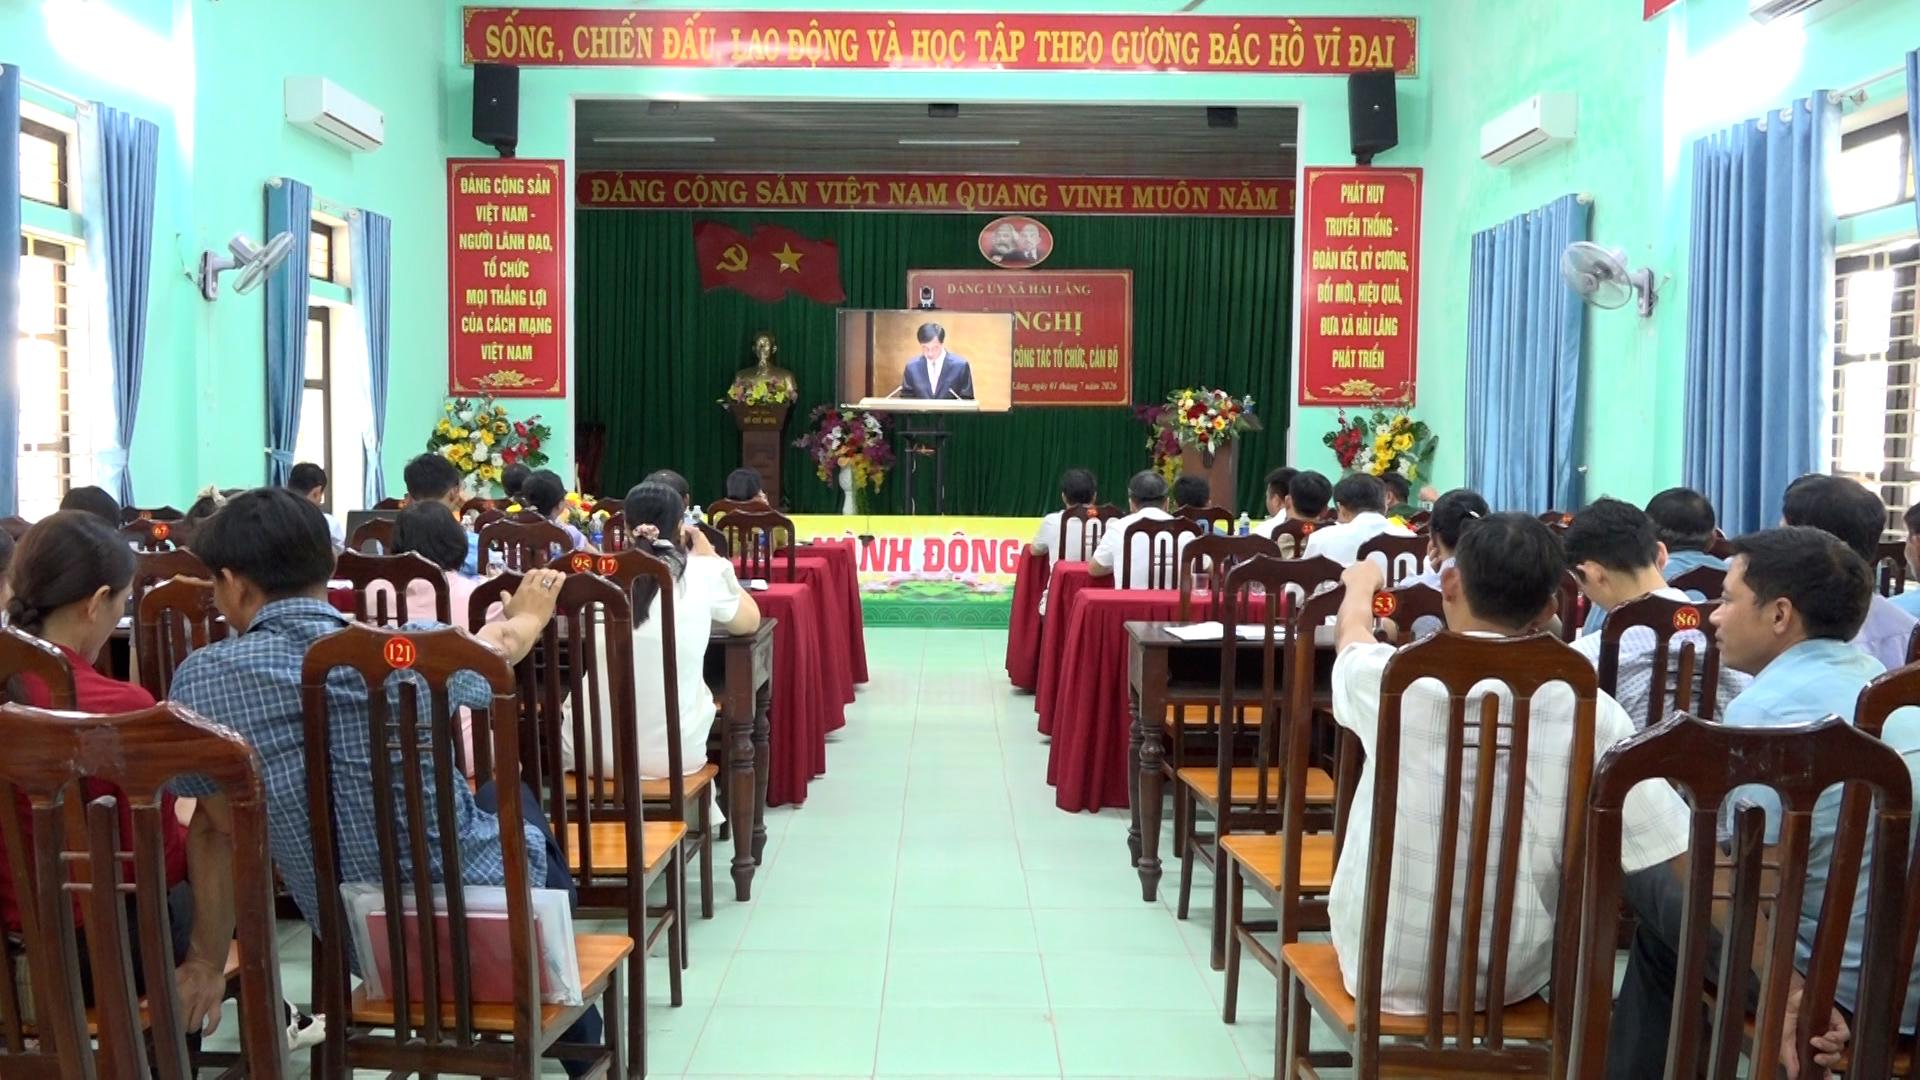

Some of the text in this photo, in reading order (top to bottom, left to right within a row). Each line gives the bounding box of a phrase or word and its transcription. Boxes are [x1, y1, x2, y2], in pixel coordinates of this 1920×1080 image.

[485, 10, 563, 62] SỐNG,
[573, 12, 653, 59] CHIẾN
[730, 28, 780, 62] LAO
[787, 19, 859, 67] ĐỘNG
[867, 19, 903, 62] VÀ
[911, 29, 965, 66] HỌC
[975, 21, 1025, 68] TẬP
[1034, 30, 1104, 64] THEO
[1111, 26, 1200, 65] GƯƠNG
[1208, 23, 1260, 66] BÁC
[1269, 18, 1305, 67] HỒ
[1314, 26, 1341, 67] VĨ
[1348, 35, 1395, 71] ĐẠI
[460, 172, 551, 197] ĐẢNG CỘNG SẢN
[591, 172, 665, 203] ĐẢNG
[673, 175, 747, 208] CỘNG
[755, 174, 808, 204] SẢN
[816, 176, 879, 209] VIỆT
[888, 181, 948, 206] NAM
[956, 181, 1048, 211] QUANG
[1057, 184, 1123, 208] VINH
[1132, 181, 1210, 210] MUÔN
[1218, 181, 1279, 210] NĂM
[1340, 180, 1385, 204] PHÁT HUY
[475, 202, 499, 225] VIỆT
[502, 206, 528, 222] NAM
[1362, 211, 1393, 238] THỐNG
[459, 229, 552, 254] NGƯỜI LÃNH ĐẠO,
[500, 257, 529, 278] CHỨC
[466, 283, 547, 310] MỌI THẮNG LỢI
[1358, 280, 1379, 307] HIỆU
[461, 312, 552, 338] CỦA CÁCH MẠNG
[1014, 311, 1083, 336] NGHỊ
[1341, 313, 1355, 336] XÃ
[481, 341, 533, 364] VIỆT NAM
[1013, 344, 1035, 368] CÔNG
[1036, 344, 1051, 368] TÁC
[1064, 344, 1088, 370] CHỨC,
[1089, 344, 1106, 368] CÁN
[1107, 344, 1119, 374] BỘ
[1332, 346, 1356, 368] PHÁT
[601, 559, 615, 570] 17
[922, 531, 1020, 580] ĐỘNG
[1676, 611, 1696, 626] 86
[389, 643, 411, 662] 121
